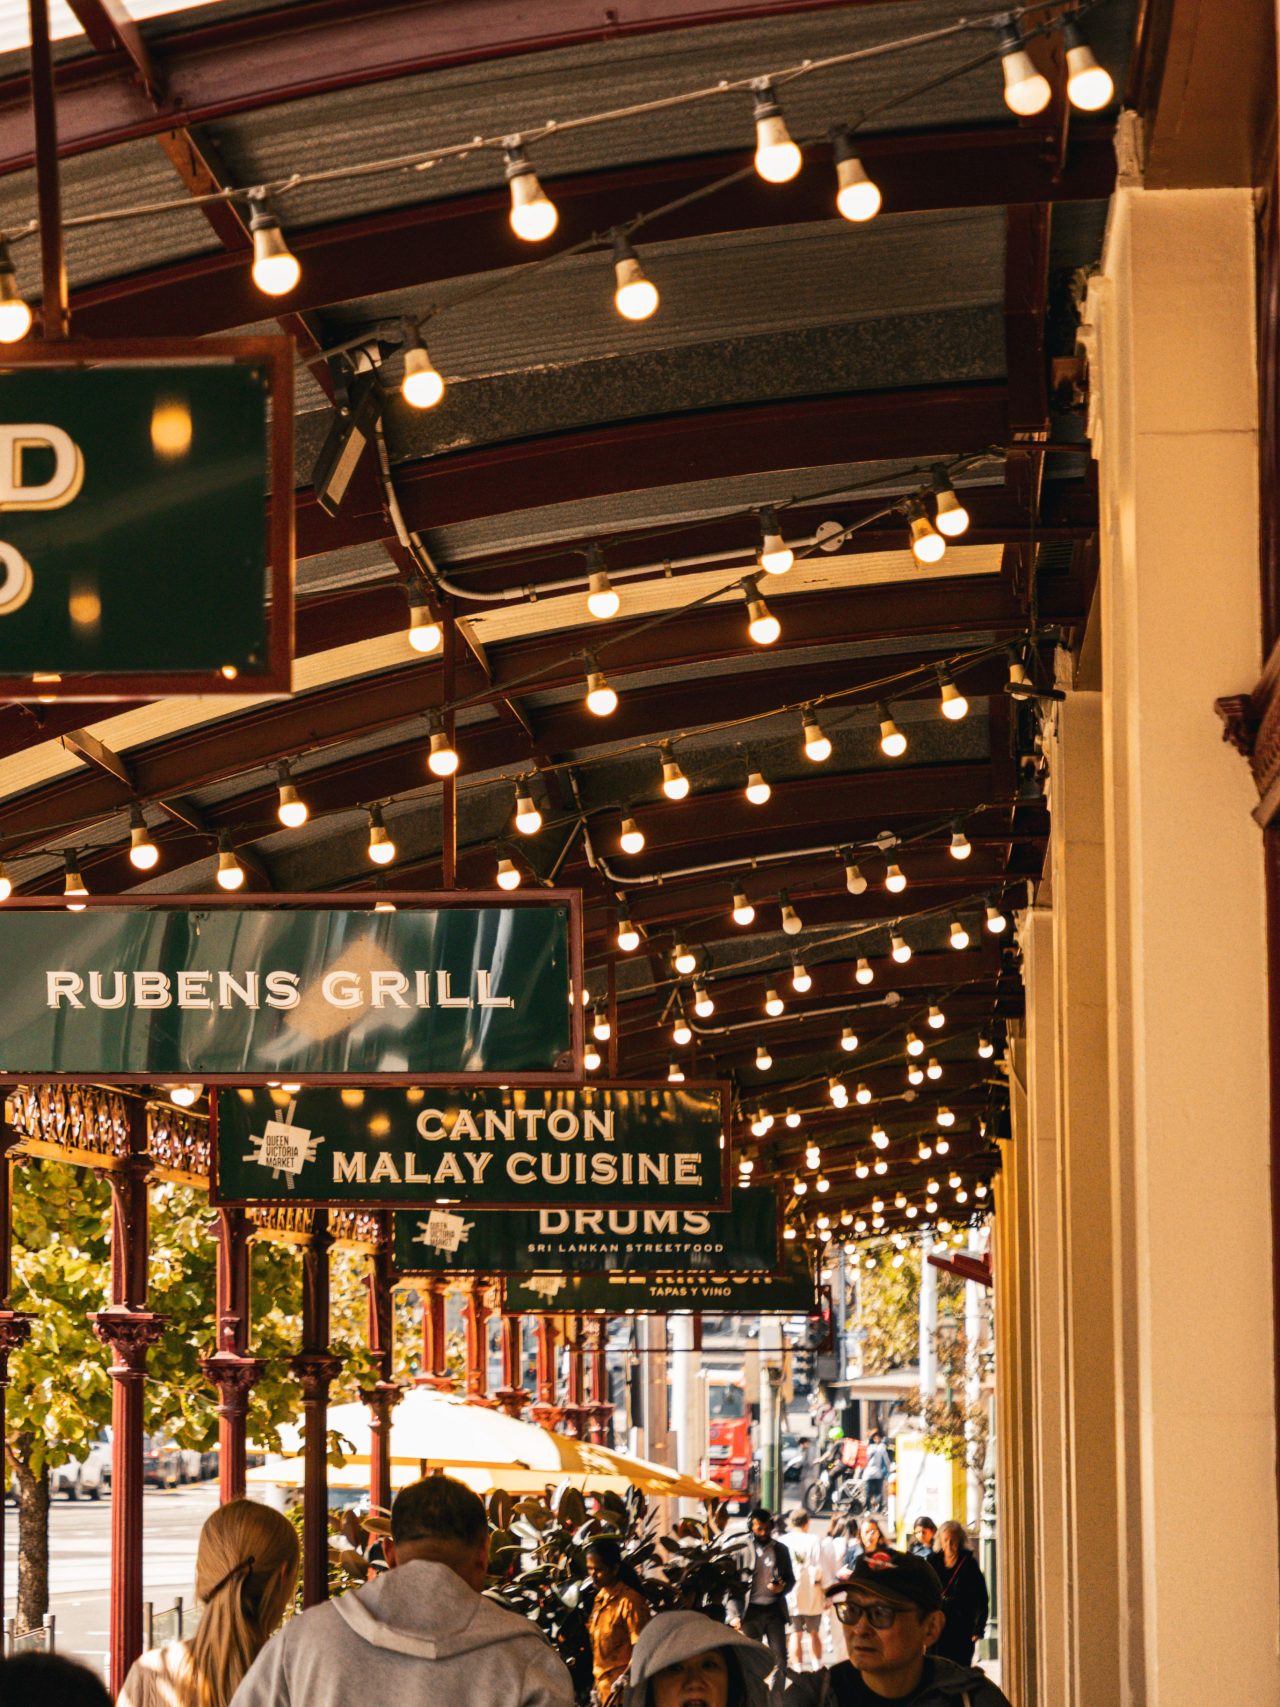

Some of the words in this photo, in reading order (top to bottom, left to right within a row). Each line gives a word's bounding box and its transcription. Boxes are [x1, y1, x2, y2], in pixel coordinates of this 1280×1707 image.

[46, 970, 301, 1010] RUBENS
[321, 969, 515, 1010] GRILL
[416, 1108, 615, 1142] CANTON
[266, 1135, 290, 1146] QUEEN
[265, 1146, 299, 1157] VICTORIA
[265, 1157, 295, 1168] MARKET
[332, 1152, 493, 1184] MALAY
[506, 1152, 703, 1186] CUISINE
[539, 1210, 711, 1236] DRUMS
[527, 1243, 552, 1253] SRI
[558, 1243, 620, 1253] LANKAN
[625, 1243, 724, 1253] STREETFOOD
[649, 1286, 687, 1297] TAPAS
[690, 1286, 700, 1296] Y
[701, 1286, 732, 1297] VINO
